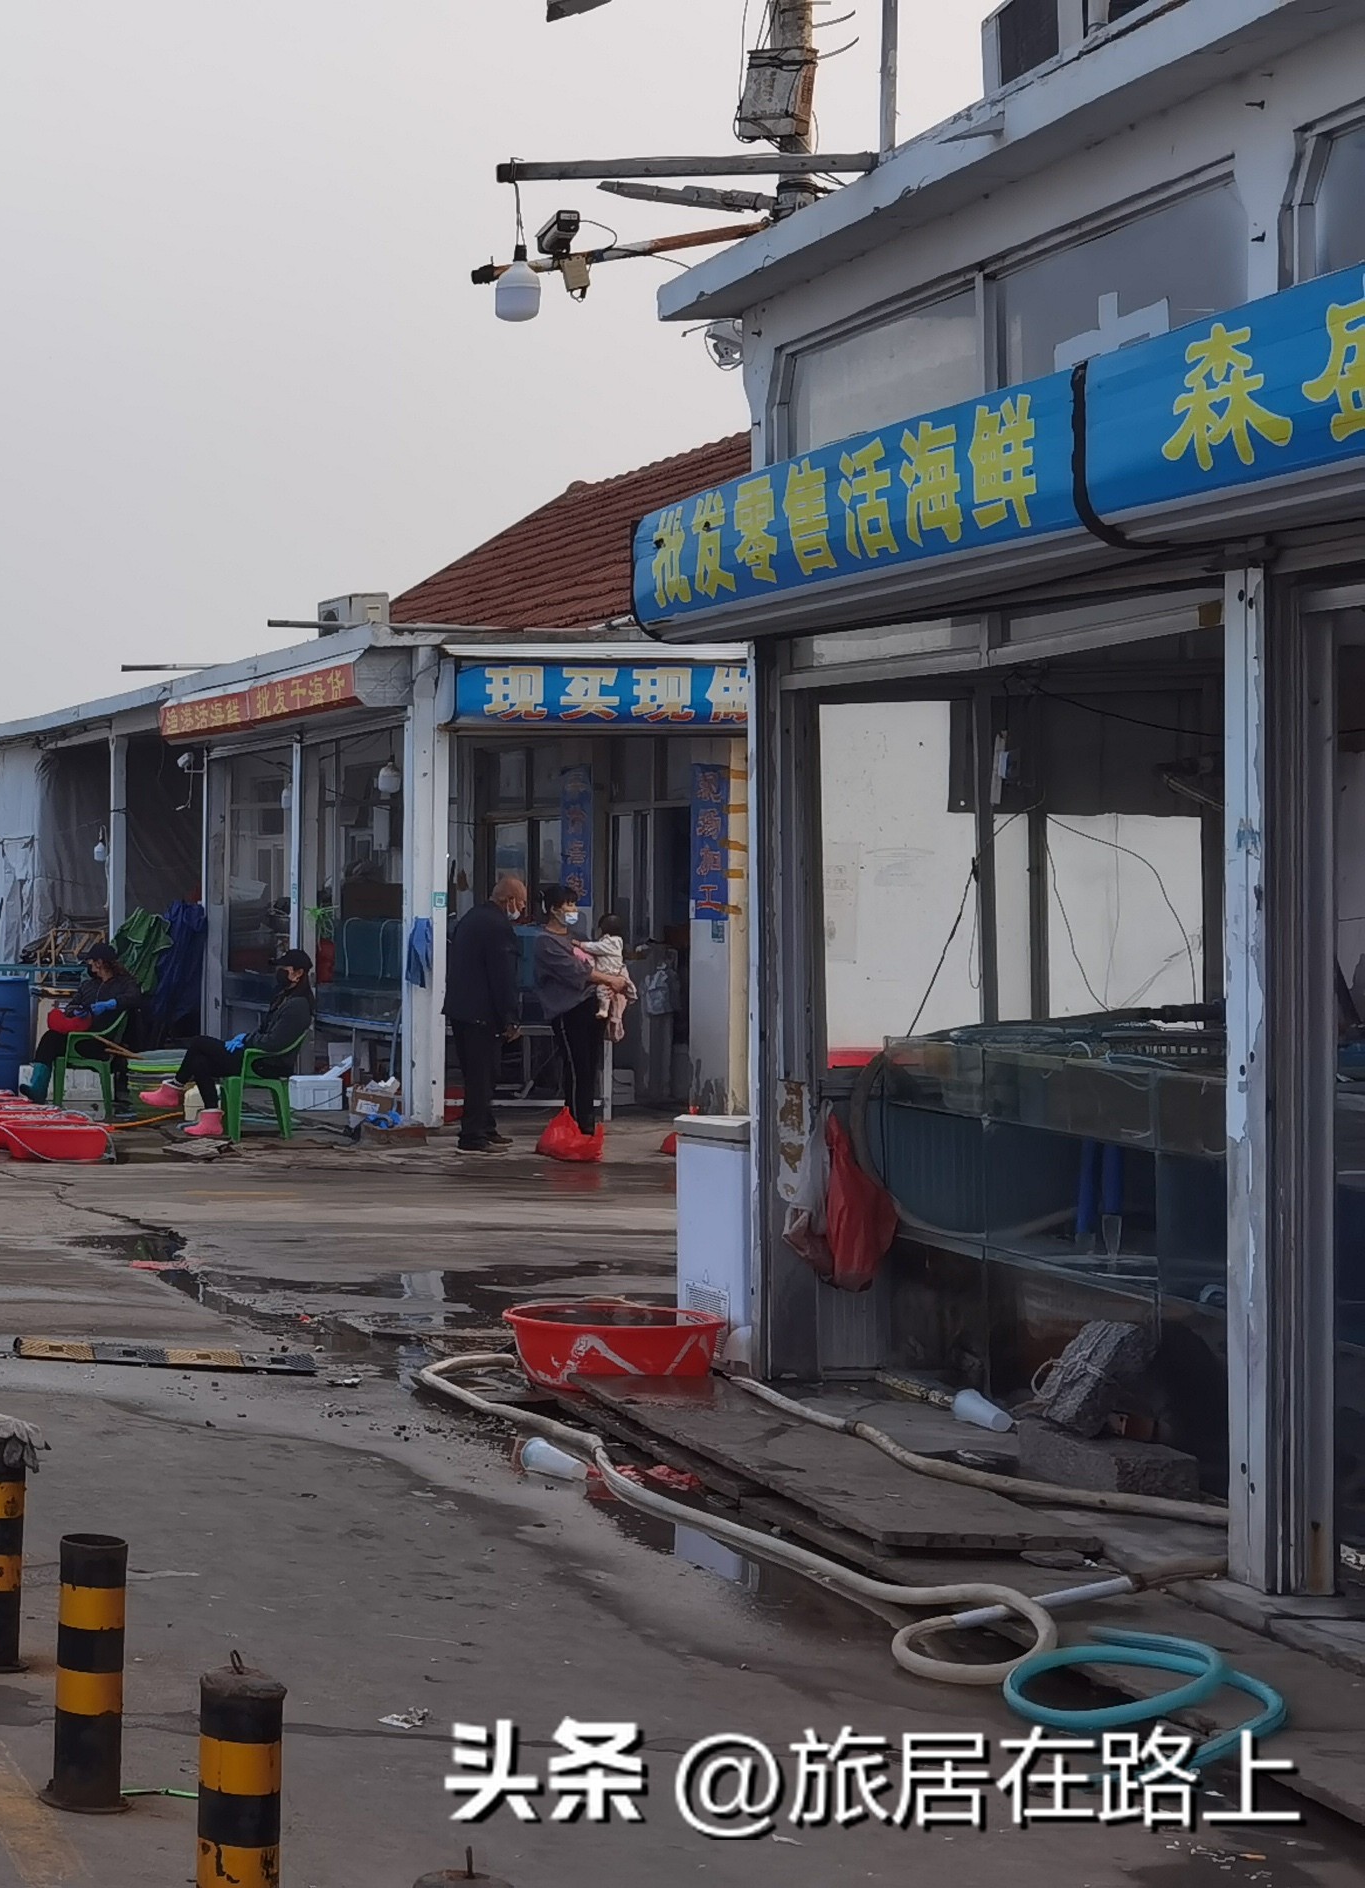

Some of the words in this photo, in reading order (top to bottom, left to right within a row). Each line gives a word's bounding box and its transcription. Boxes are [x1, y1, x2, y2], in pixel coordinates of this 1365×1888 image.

[652, 394, 1037, 608] 批发零售活海鲜
[256, 669, 346, 719] 批发干海货
[483, 665, 748, 723] 现买现做
